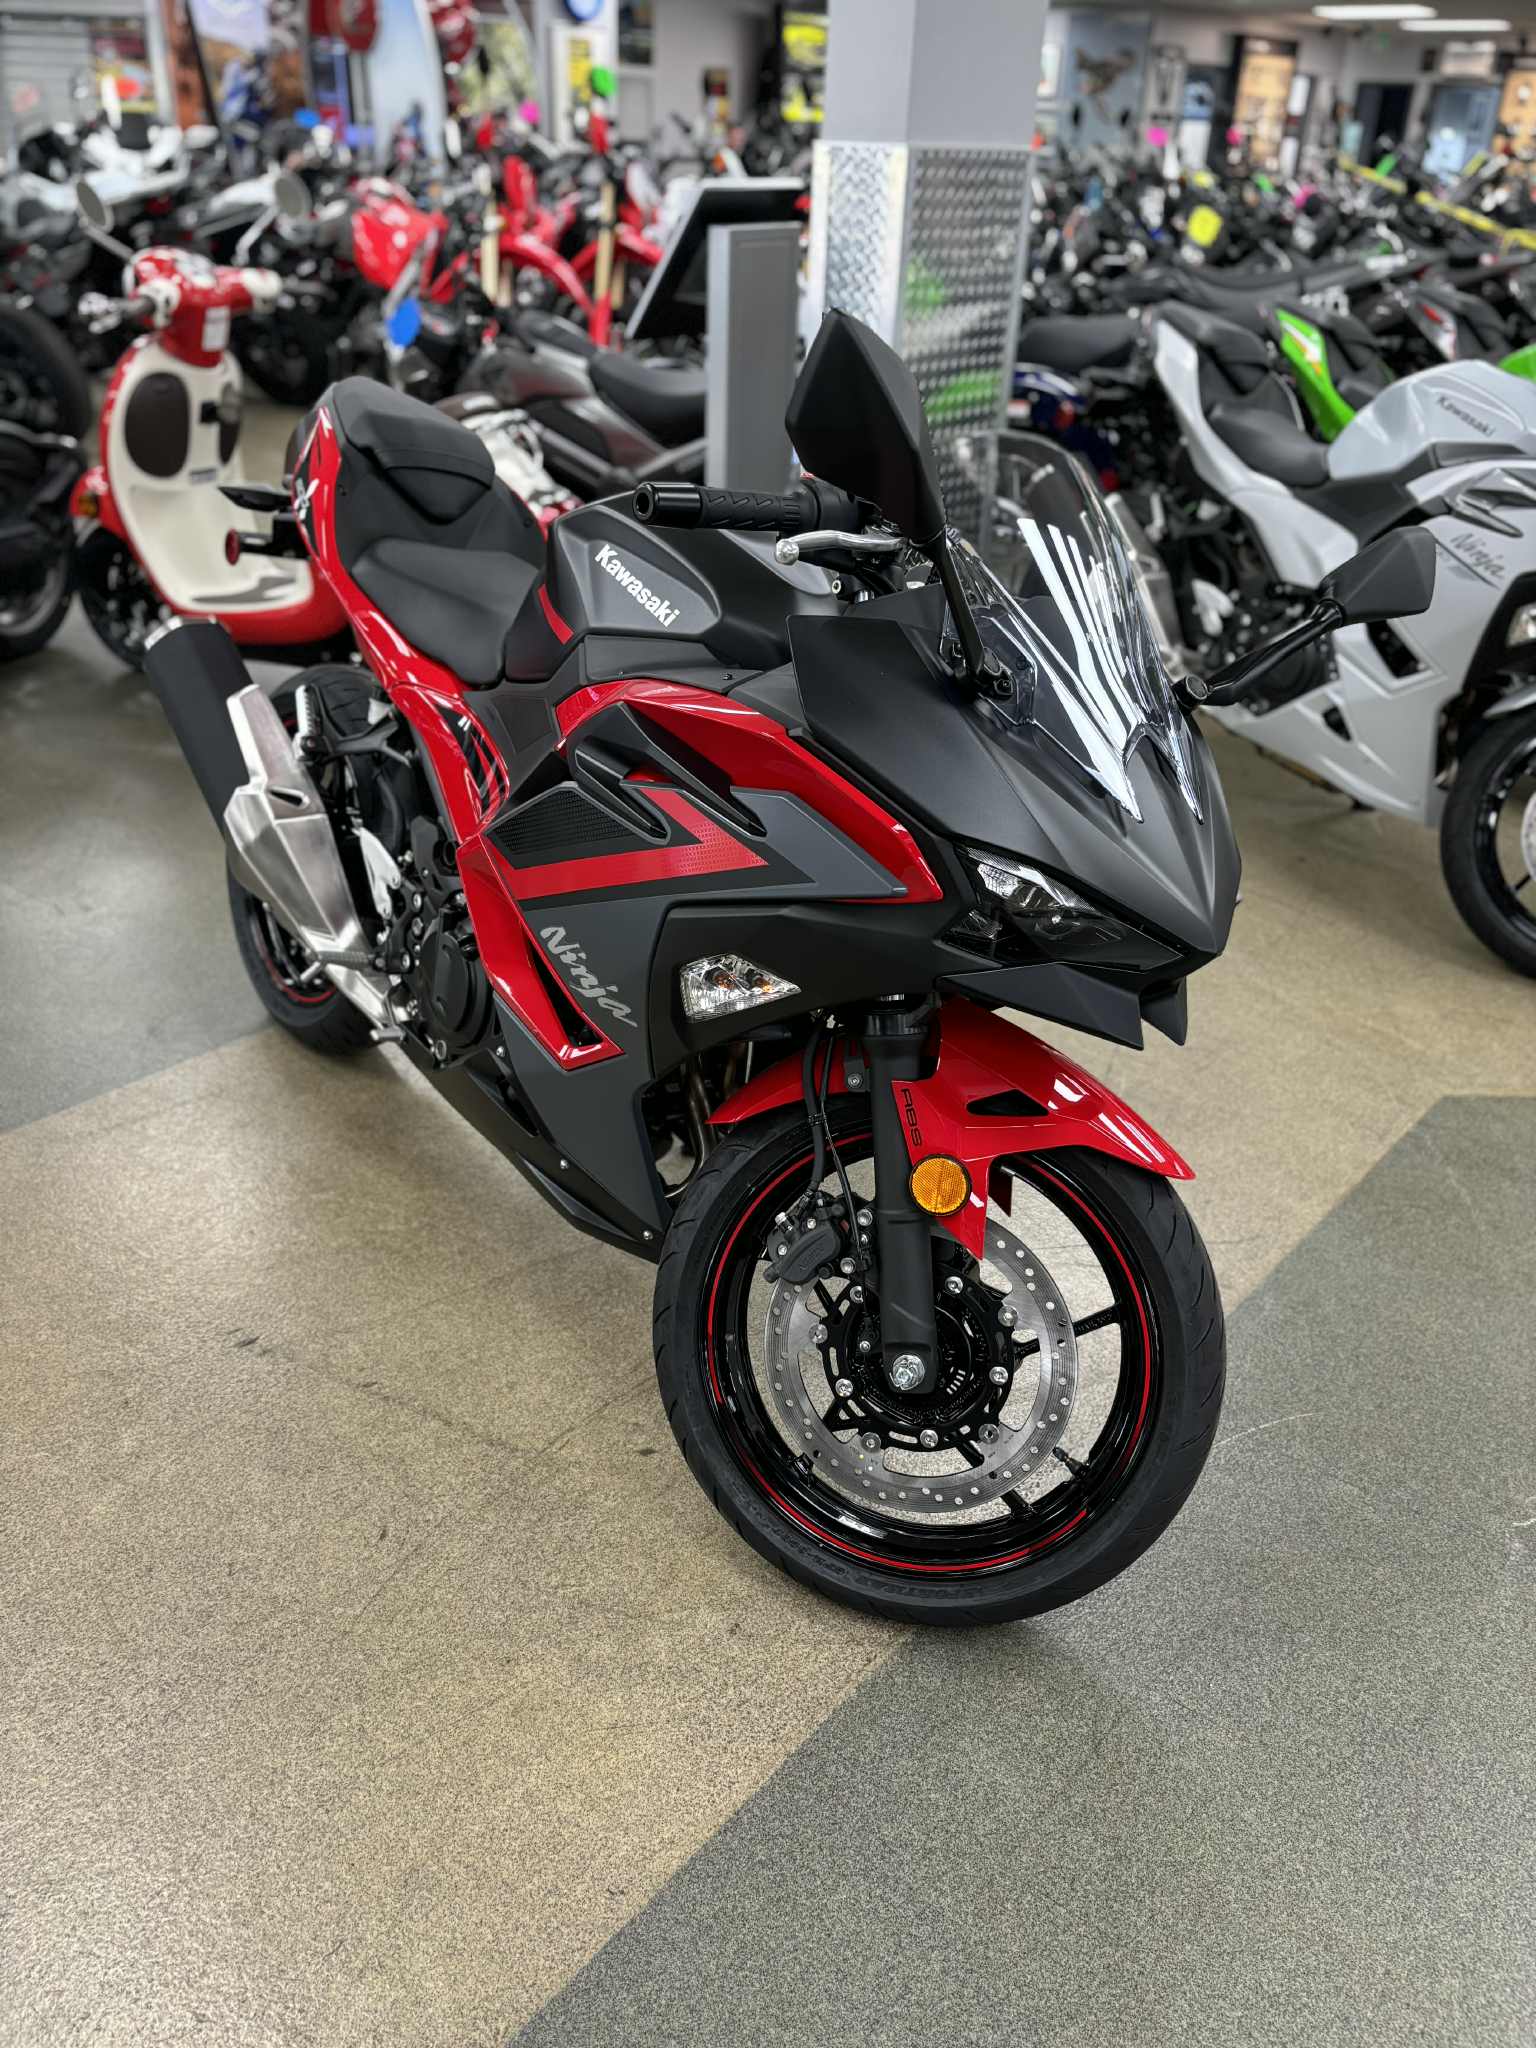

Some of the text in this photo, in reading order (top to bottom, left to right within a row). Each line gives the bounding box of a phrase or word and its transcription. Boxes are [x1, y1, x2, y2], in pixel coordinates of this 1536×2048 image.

[594, 543, 680, 627] Kawasaki
[1450, 533, 1505, 579] Ninja
[540, 926, 638, 1028] Ninja
[901, 1088, 922, 1146] ABS
